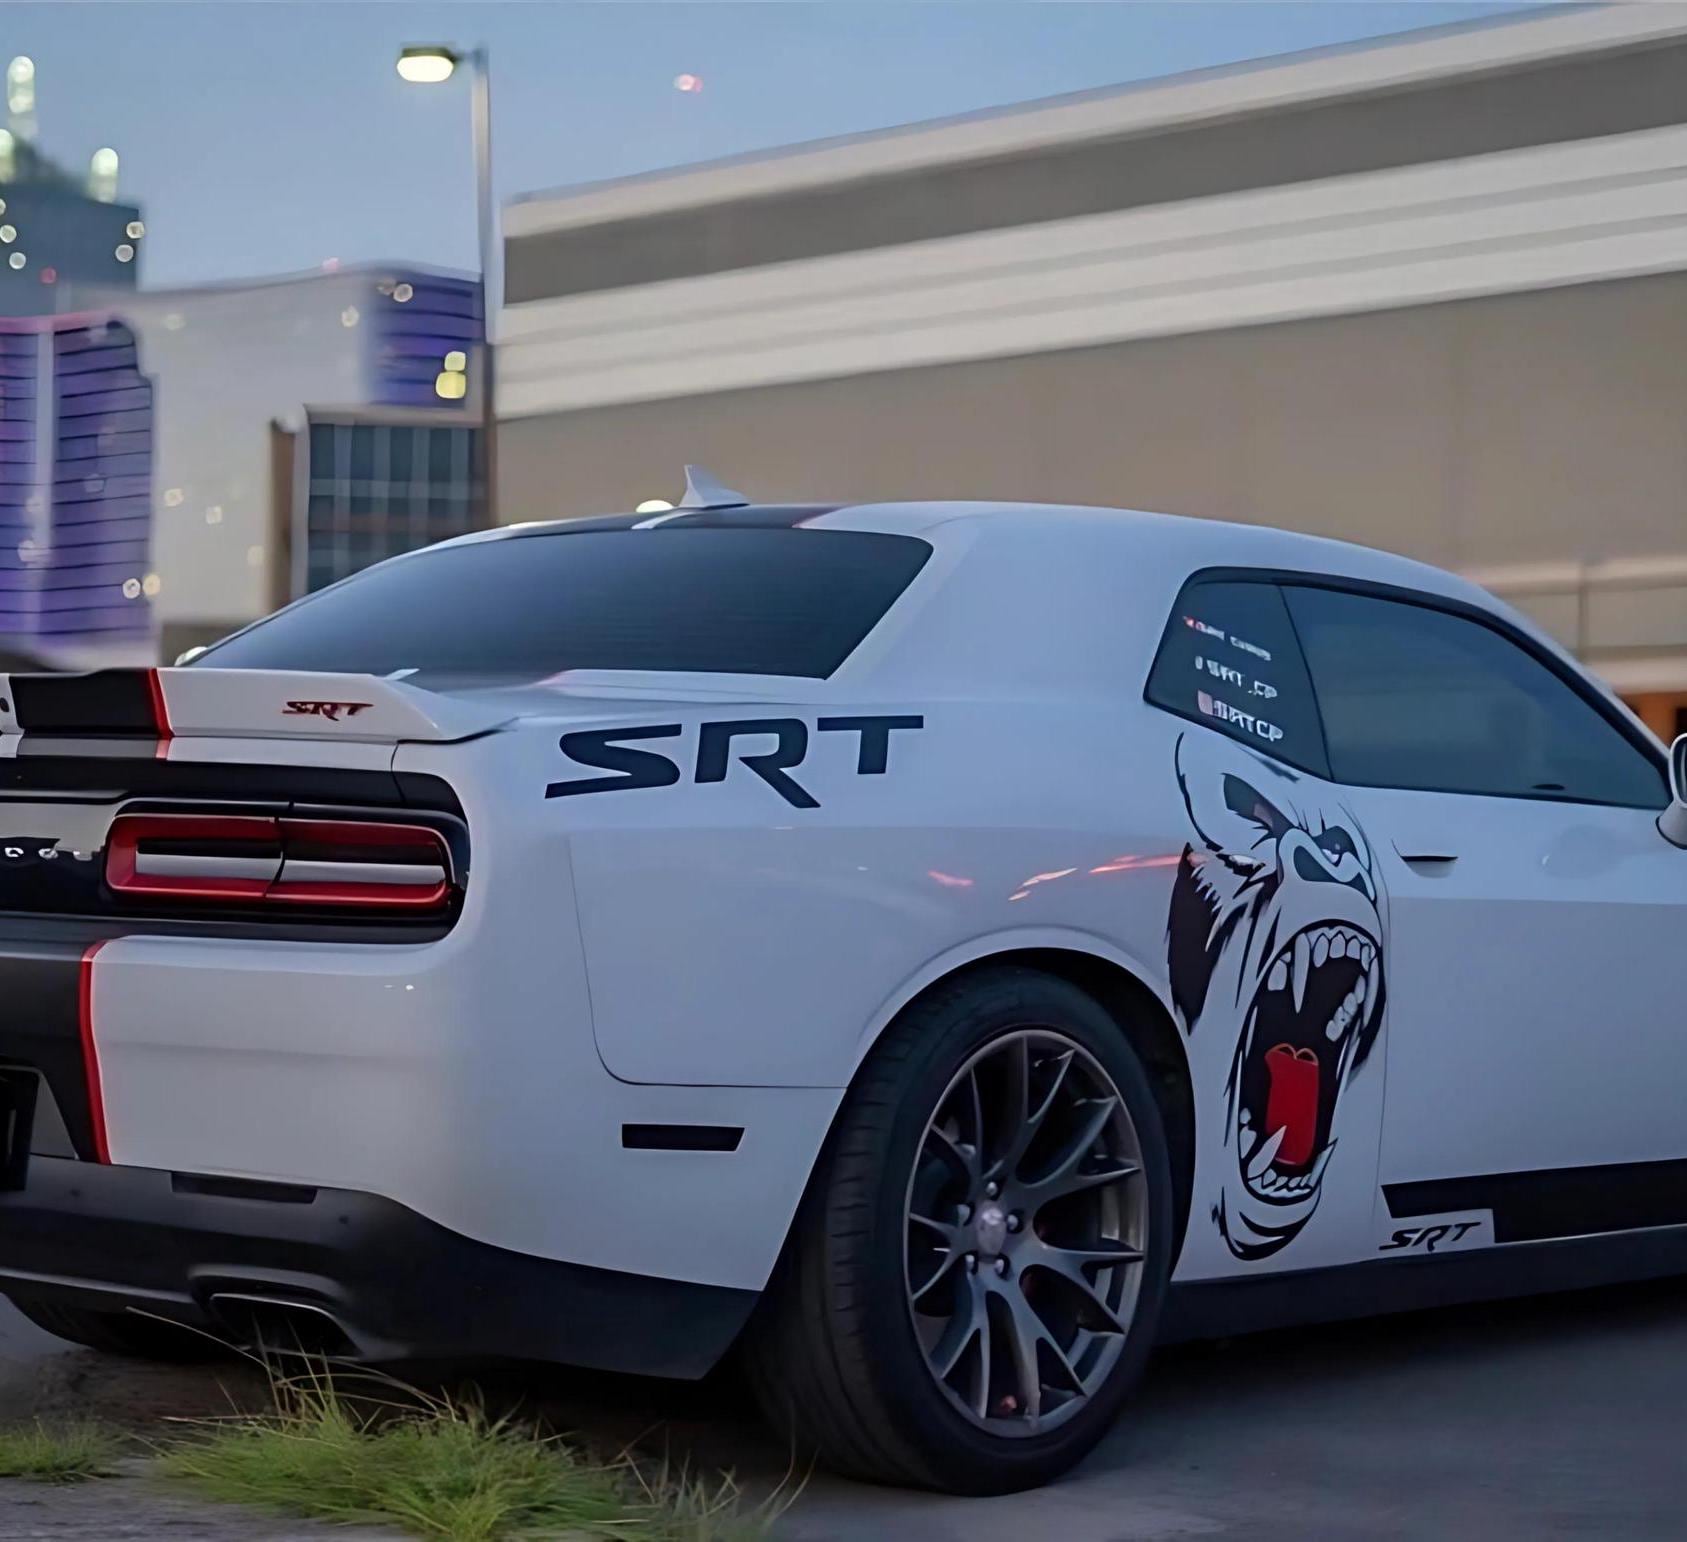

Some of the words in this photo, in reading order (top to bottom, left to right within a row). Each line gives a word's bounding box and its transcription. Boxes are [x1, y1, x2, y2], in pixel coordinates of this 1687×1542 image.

[282, 701, 374, 721] SRT
[545, 715, 924, 808] SRT
[1379, 1222, 1481, 1252] SRT
